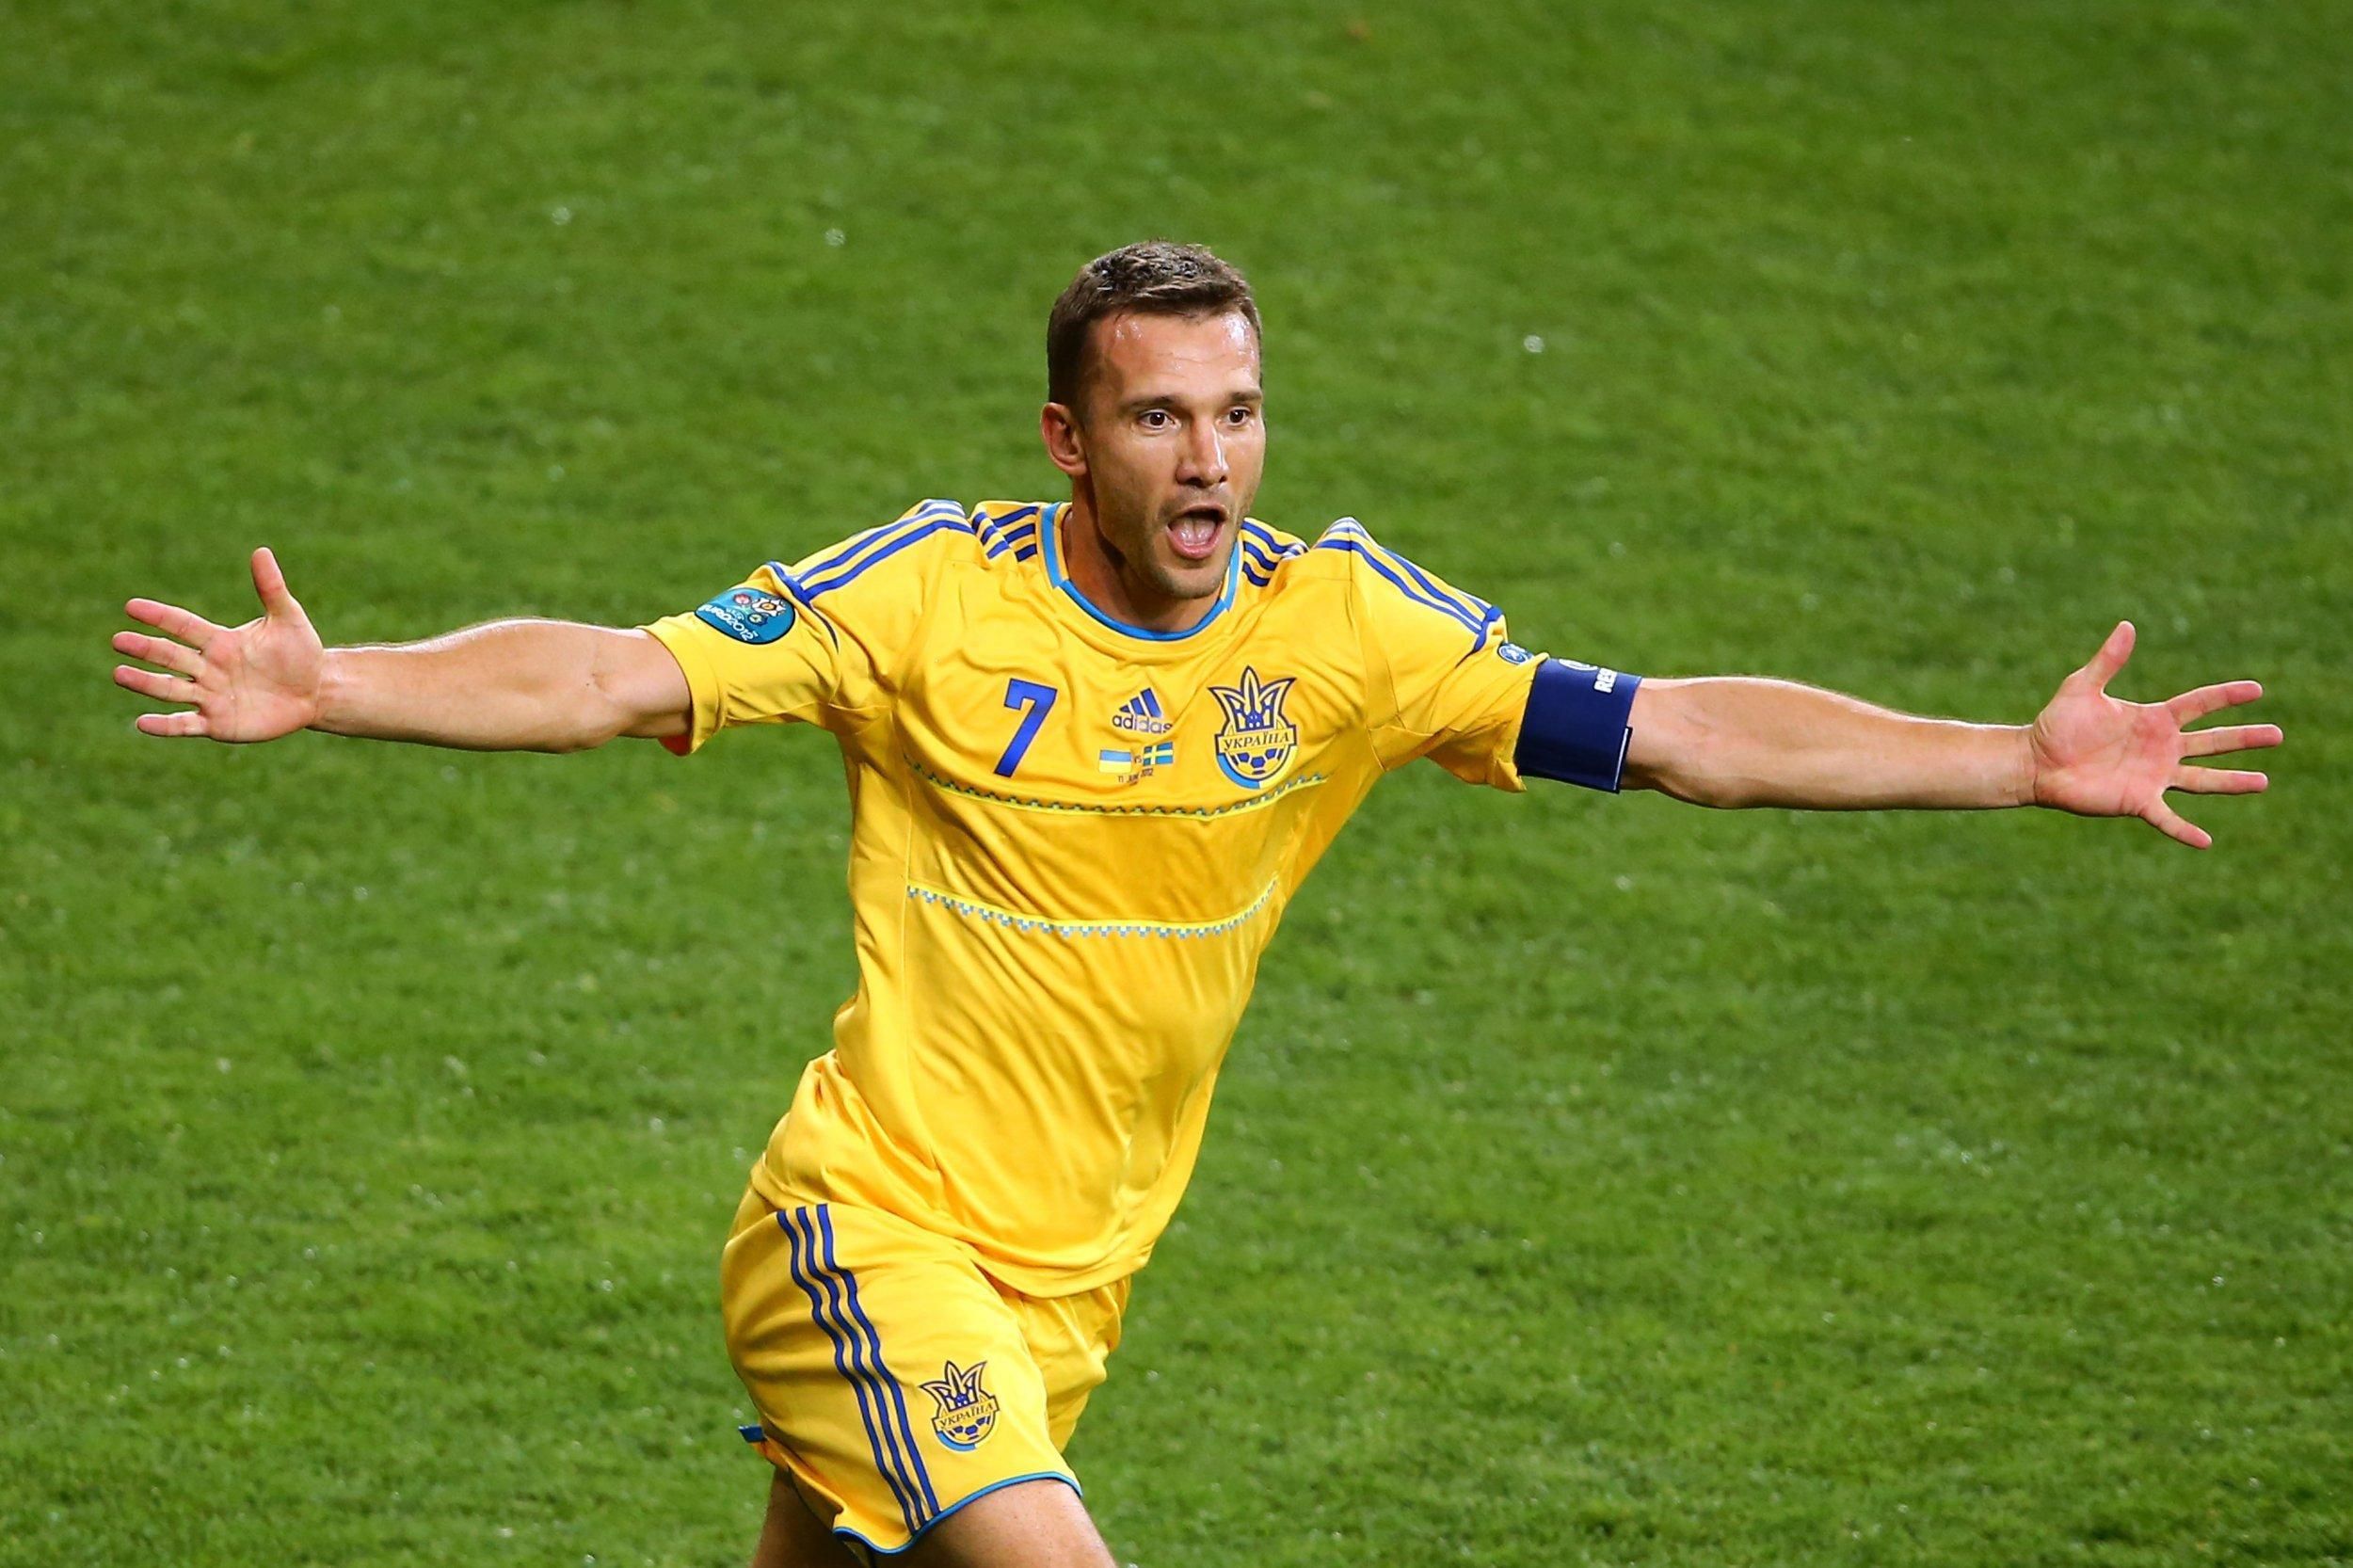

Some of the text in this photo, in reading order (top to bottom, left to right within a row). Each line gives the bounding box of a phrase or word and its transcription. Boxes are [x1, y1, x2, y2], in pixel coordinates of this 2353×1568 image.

[993, 678, 1058, 778] 7
[1112, 712, 1173, 734] adidas
[1224, 731, 1289, 752] УКРАЇНА
[939, 1401, 994, 1431] УКРАЇНА
